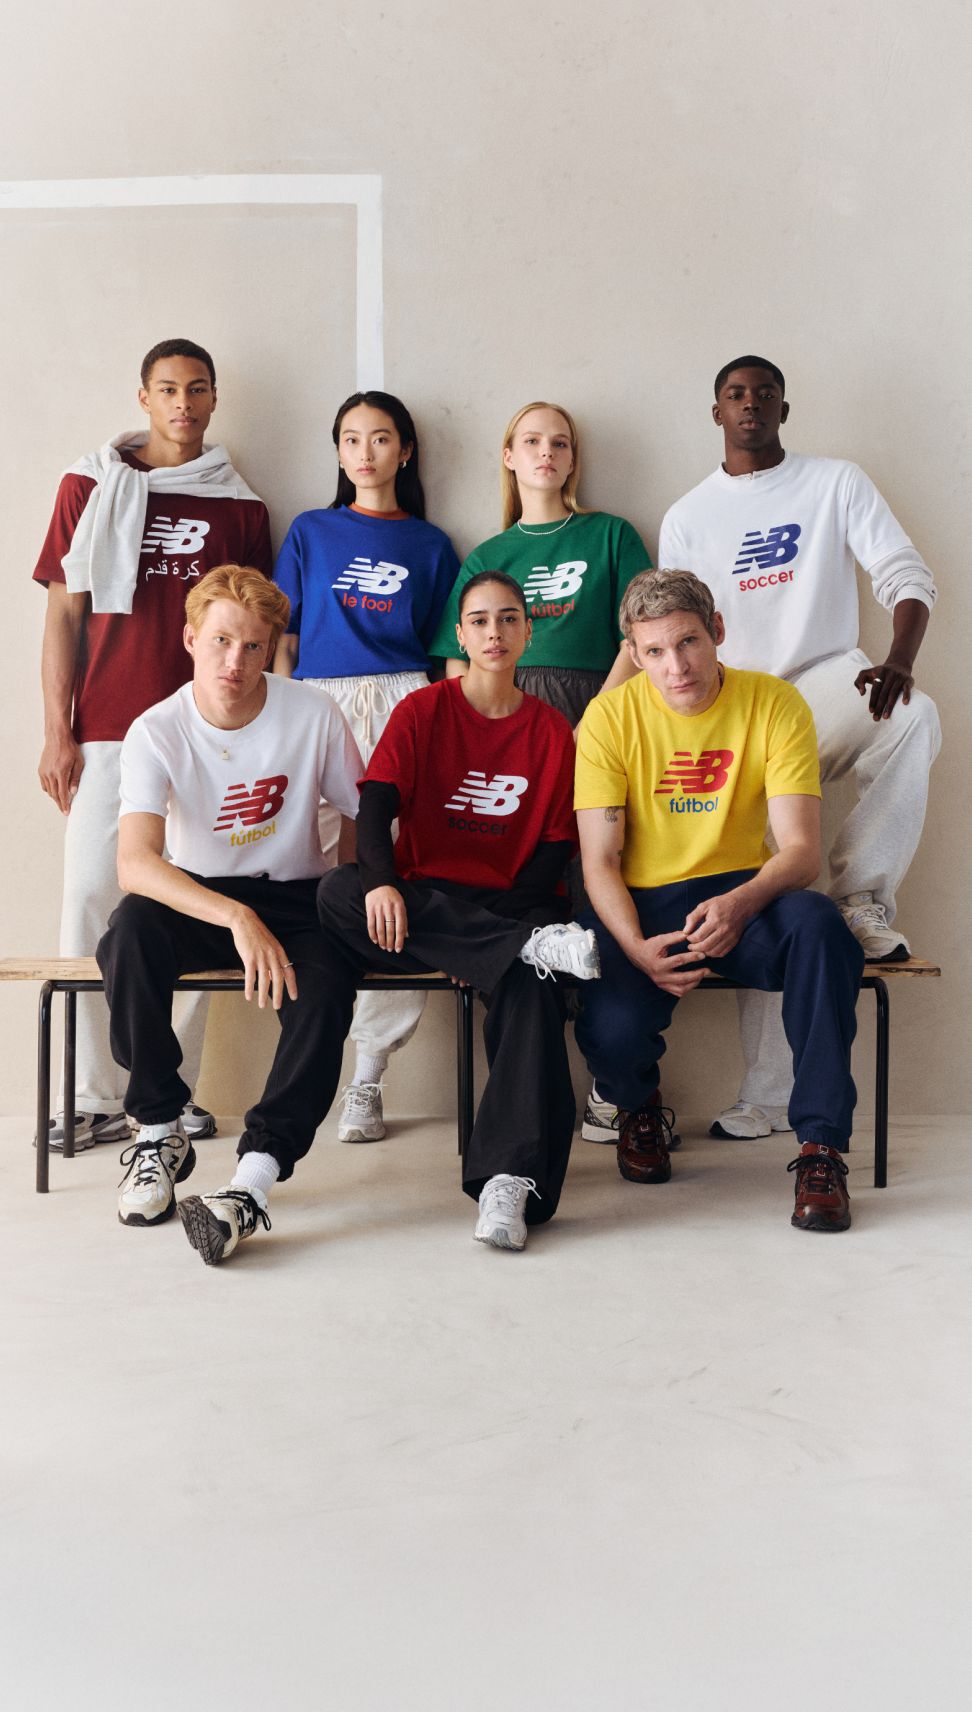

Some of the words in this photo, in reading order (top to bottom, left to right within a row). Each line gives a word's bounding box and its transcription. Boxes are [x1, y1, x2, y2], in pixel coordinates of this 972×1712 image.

[141, 516, 210, 554] NB
[732, 523, 801, 574] NB
[145, 560, 168, 581] قدم
[172, 560, 200, 580] كرة
[331, 557, 409, 595] NB
[523, 560, 588, 602] NB
[739, 569, 794, 592] soccer
[342, 592, 357, 608] le
[361, 599, 392, 612] foot
[531, 598, 575, 617] fútbol
[654, 749, 734, 794] NB
[213, 774, 289, 831] NB
[444, 770, 529, 816] NB
[670, 797, 718, 813] fútbol
[230, 821, 277, 847] fútbol
[447, 816, 508, 835] soccer
